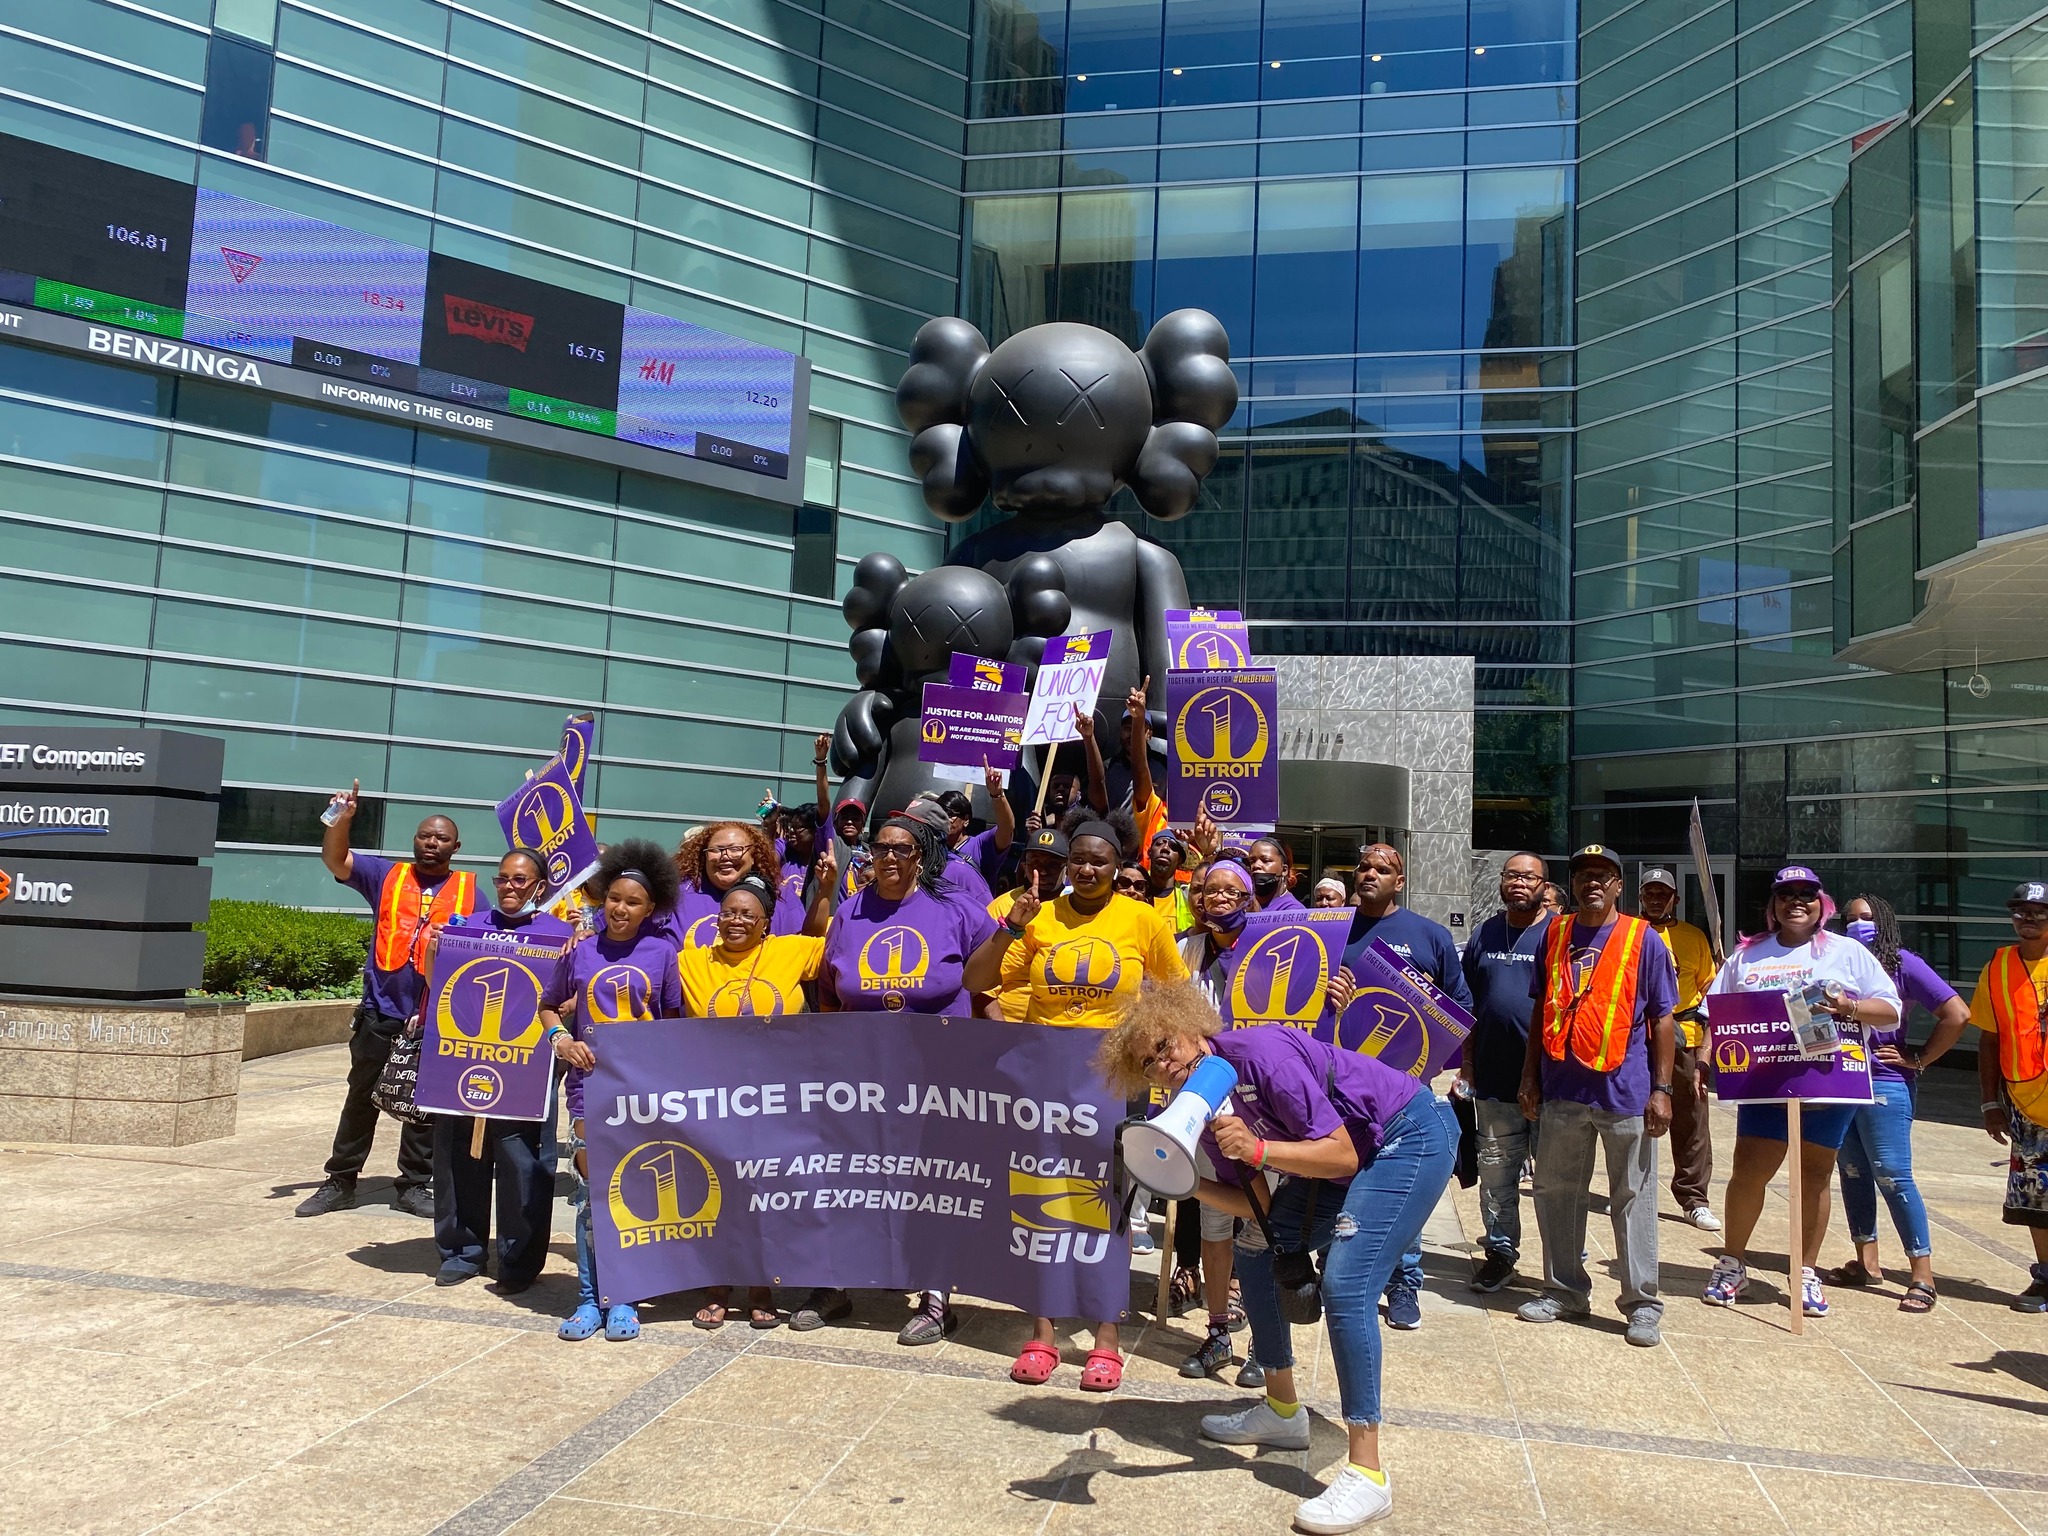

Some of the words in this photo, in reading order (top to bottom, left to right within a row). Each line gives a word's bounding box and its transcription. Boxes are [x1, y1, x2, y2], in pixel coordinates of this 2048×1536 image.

[106, 223, 169, 252] 106.81
[362, 289, 405, 312] 18.34
[88, 327, 262, 386] BENZINGA
[568, 342, 605, 364] 16.75
[313, 350, 342, 367] 0.00
[370, 364, 392, 378] 0%
[638, 355, 676, 386] H&M
[451, 382, 478, 398] LEVI
[745, 390, 779, 409] 12.20
[322, 383, 410, 412] INFORMING
[413, 402, 443, 420] THE
[445, 411, 494, 431] GLOBE
[711, 443, 733, 458] 0.00
[753, 452, 769, 467] 0%
[1068, 635, 1089, 643] LOCAL
[976, 659, 1000, 669] LOCAL
[1062, 653, 1088, 664] SEIU
[971, 680, 1002, 692] SEIU
[1037, 665, 1103, 697] UNION
[1168, 676, 1195, 685] TOGETHER
[1196, 676, 1205, 684] WE
[1221, 675, 1232, 683] FOR
[925, 707, 962, 718] JUSTICE
[964, 711, 983, 720] FOR
[984, 714, 1024, 725] JANITORS
[964, 735, 999, 744] EXPENDABLE
[1027, 721, 1080, 742] ALL
[0, 744, 30, 763] ET
[32, 745, 146, 769] Companies
[1002, 743, 1020, 752] SEIU
[1181, 763, 1262, 778] DETROIT
[38, 804, 110, 827] moran
[1210, 804, 1233, 812] SEIU
[539, 822, 575, 857] TROIT
[14, 873, 73, 903] bmc
[1246, 914, 1272, 926] TOGETHER
[1273, 914, 1281, 922] WE
[1282, 913, 1294, 922] RISE
[1296, 912, 1308, 921] FOR
[482, 932, 519, 944] LOCAL
[440, 937, 471, 950] TOGETHER
[473, 941, 483, 950] WE
[485, 944, 500, 952] RISE
[501, 945, 515, 954] FOR
[515, 946, 562, 960] #ONEDETRO
[1487, 951, 1536, 962] whteve
[860, 977, 925, 990] DETROIT
[1363, 951, 1391, 975] TOGETHER
[1389, 973, 1401, 985] WE
[1399, 982, 1412, 997] RISE
[1411, 992, 1425, 1006] FOR
[1401, 966, 1434, 995] LOCAL
[1048, 986, 1113, 1000] DETROIT
[0, 1011, 71, 1045] Campus
[89, 1015, 171, 1045] Martius
[1714, 1022, 1768, 1036] JUSTICE
[1771, 1021, 1794, 1032] FO
[1835, 1021, 1860, 1033] TORS
[438, 1039, 535, 1064] DETROIT
[1768, 1044, 1787, 1052] ARE
[1719, 1066, 1749, 1074] DETROIT
[1757, 1056, 1776, 1064] NOT
[1842, 1062, 1866, 1072] SEIU
[470, 1074, 490, 1082] LOCAL
[466, 1090, 492, 1100] SEIU
[605, 1083, 787, 1126] JUSTICE
[800, 1081, 886, 1114] FOR
[897, 1083, 1099, 1137] JANITORS
[1185, 1116, 1197, 1135] PYLE
[735, 1157, 781, 1179] WE
[785, 1154, 843, 1176] ARE
[848, 1153, 992, 1188] ESSENTIAL,
[1009, 1151, 1085, 1177] LOCAL
[1097, 1161, 1108, 1178] 1
[749, 1190, 808, 1212] NOT
[813, 1189, 984, 1219] EXPENDABLE
[619, 1222, 717, 1249] DETROIT
[1010, 1226, 1110, 1264] SEIU
